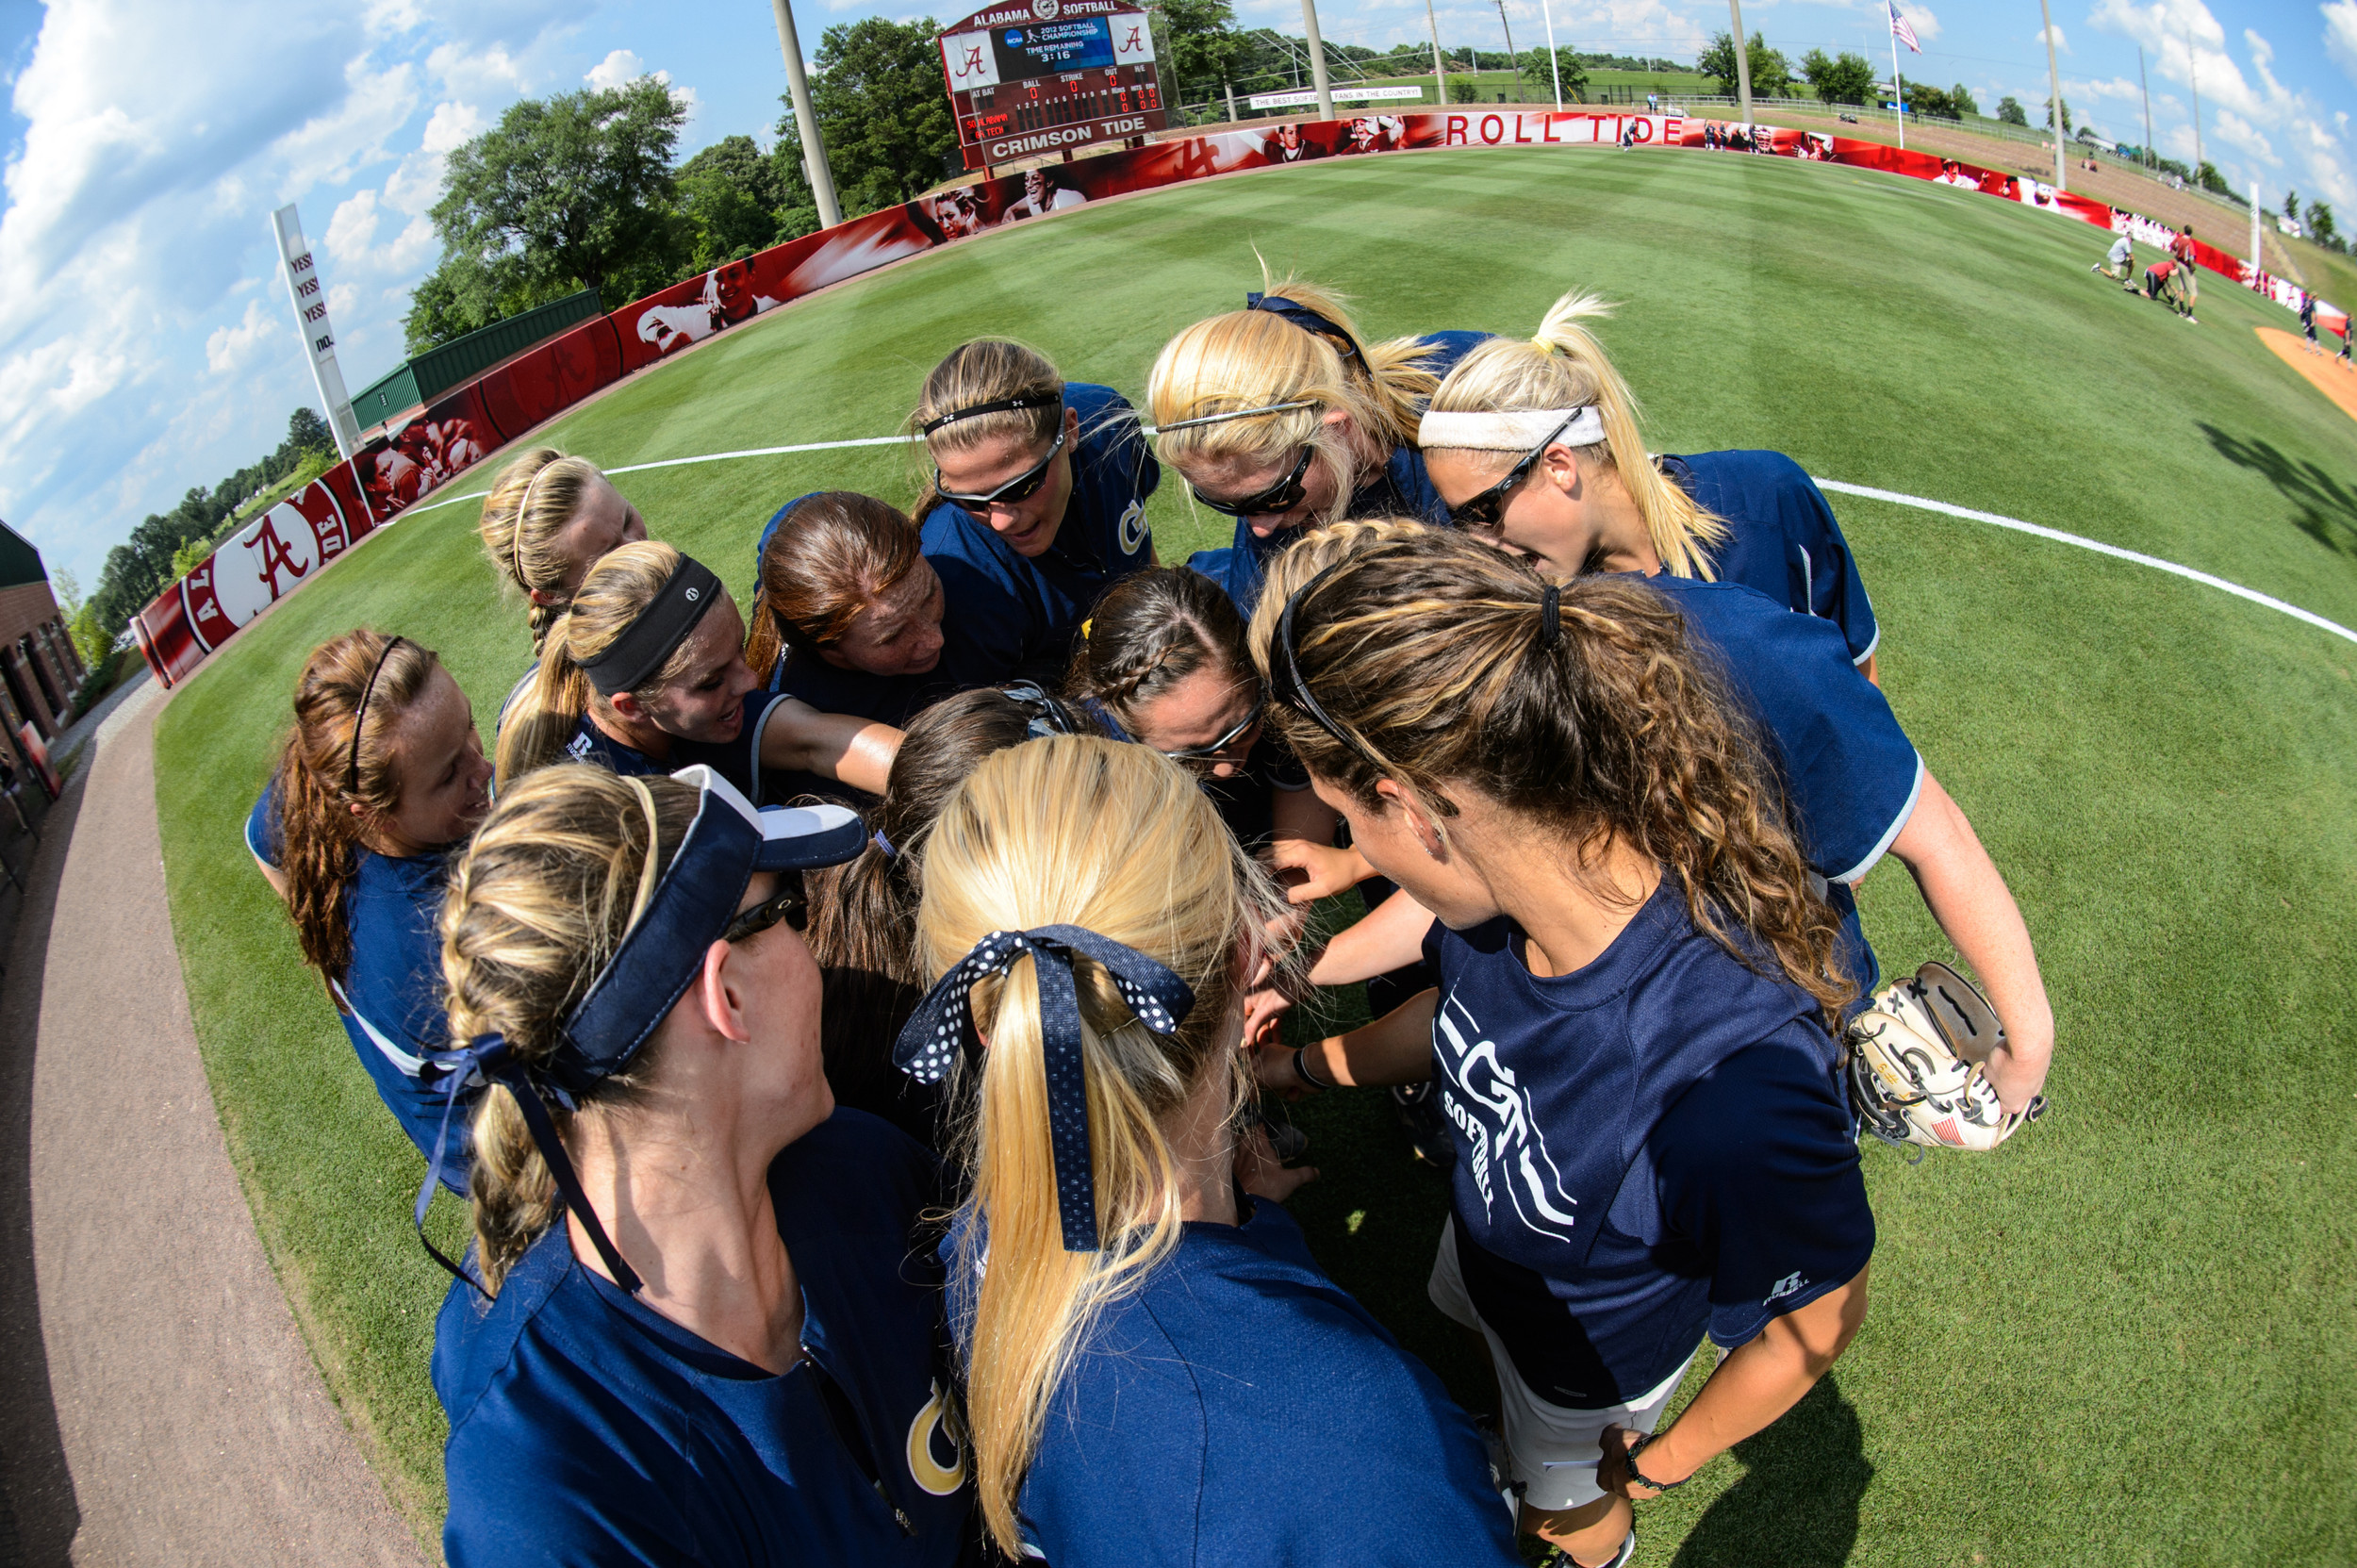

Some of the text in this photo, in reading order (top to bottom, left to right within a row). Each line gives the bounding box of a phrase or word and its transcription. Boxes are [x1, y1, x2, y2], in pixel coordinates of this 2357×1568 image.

[974, 8, 1030, 26] ALABAMA
[1063, 1, 1117, 15] SOFTBALL
[1041, 23, 1096, 35] 2012 SOFTBALL
[1042, 28, 1098, 41] CHAMPIONSHIP
[1026, 41, 1084, 55] TIME REMAINING
[1041, 50, 1071, 62] 3:16
[1060, 73, 1083, 83] STRIKE
[1104, 67, 1117, 76] OUT
[1022, 79, 1041, 89] BALL
[1069, 80, 1078, 92] 0
[1109, 74, 1117, 87] 0
[981, 87, 995, 96] BAT
[1030, 87, 1038, 99] 0
[1120, 91, 1127, 102] 0
[1138, 90, 1145, 99] 0
[1148, 88, 1155, 98] 0
[986, 125, 1004, 137] TECH
[1122, 103, 1129, 113] 0
[1140, 100, 1146, 109] 0
[1150, 98, 1157, 108] 0
[1445, 113, 1682, 146] ROLL TIDE
[992, 117, 1146, 157] CRIMSON TIDE
[290, 252, 313, 274] YES!
[297, 276, 320, 298] YES!
[304, 301, 327, 323] YES!
[316, 335, 335, 353] no.
[1443, 1090, 1493, 1226] SOFTBALL
[1763, 1279, 1810, 1306] RUSSELL
